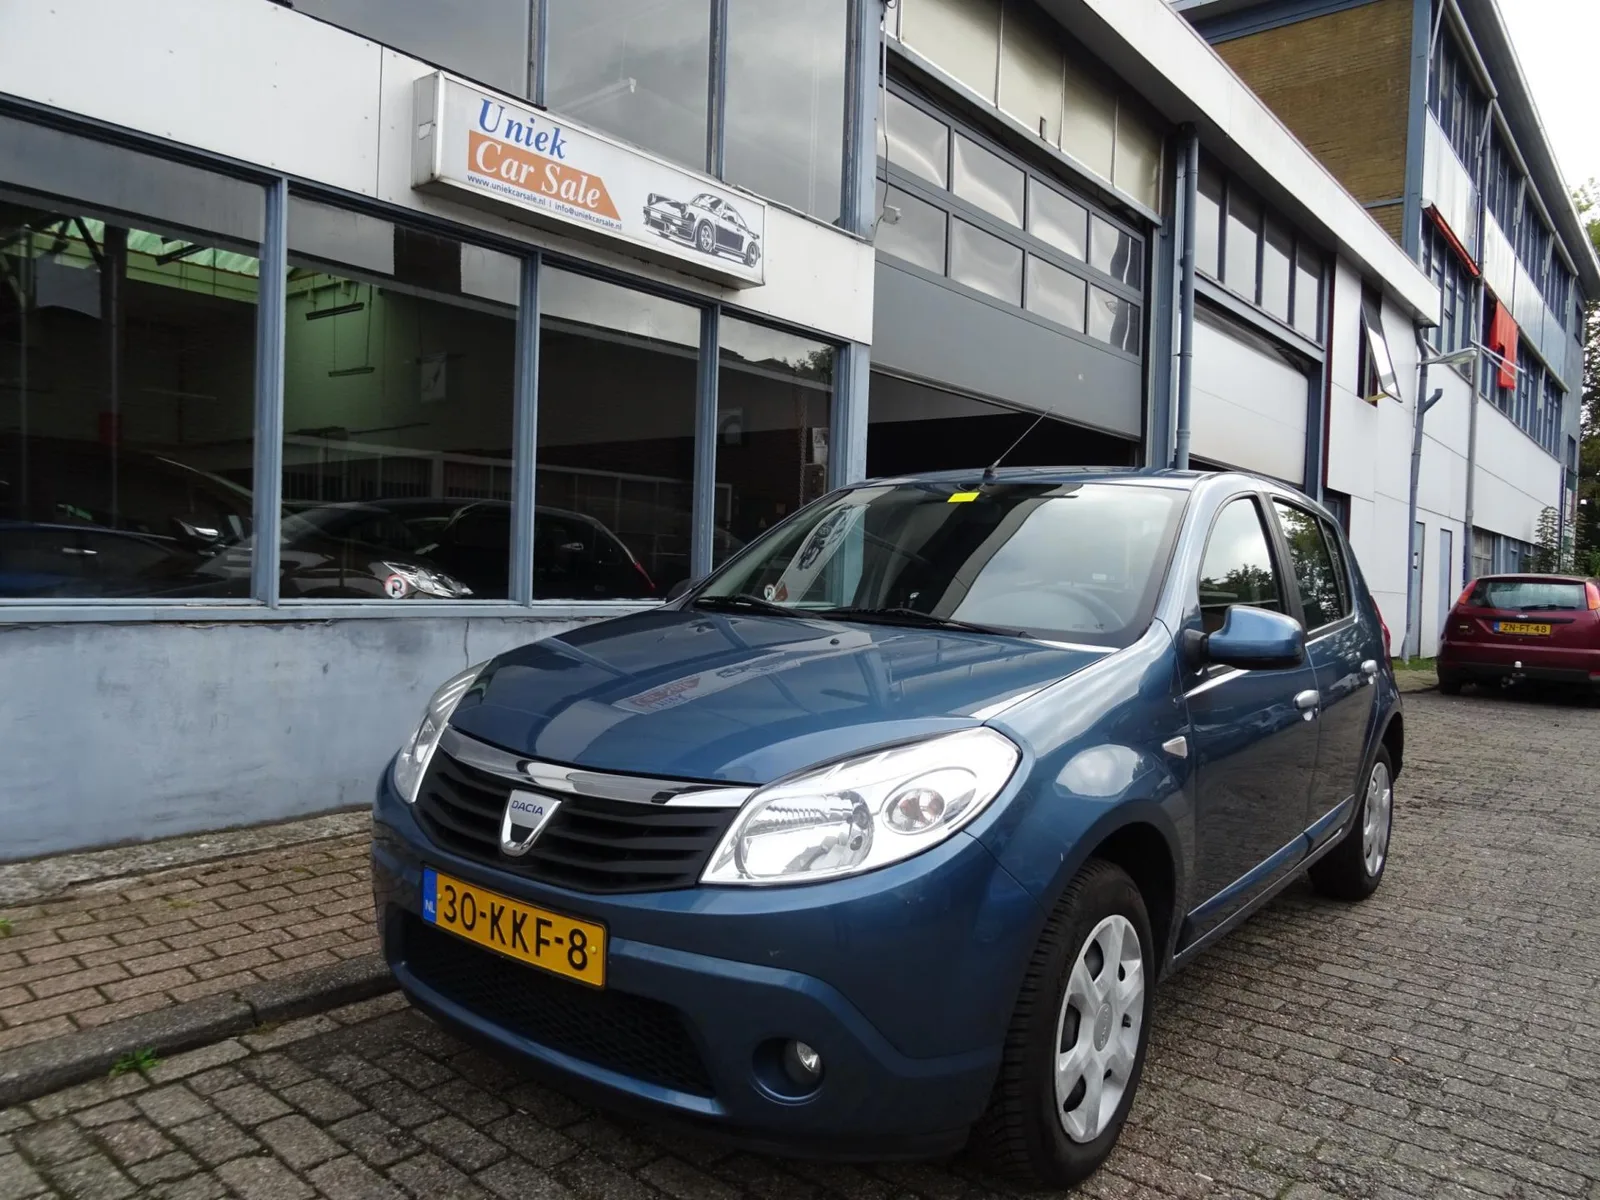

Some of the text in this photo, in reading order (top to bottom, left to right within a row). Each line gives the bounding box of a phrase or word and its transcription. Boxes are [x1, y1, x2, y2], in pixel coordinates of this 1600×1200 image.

[479, 98, 567, 159] Uniek
[467, 174, 622, 230] www.uniekcarsale.nl info@uniekcarsale.nl
[475, 140, 601, 208] Car Sale
[511, 800, 543, 815] DACIA
[424, 899, 436, 914] NL
[443, 885, 588, 971] 30-KKF-8
